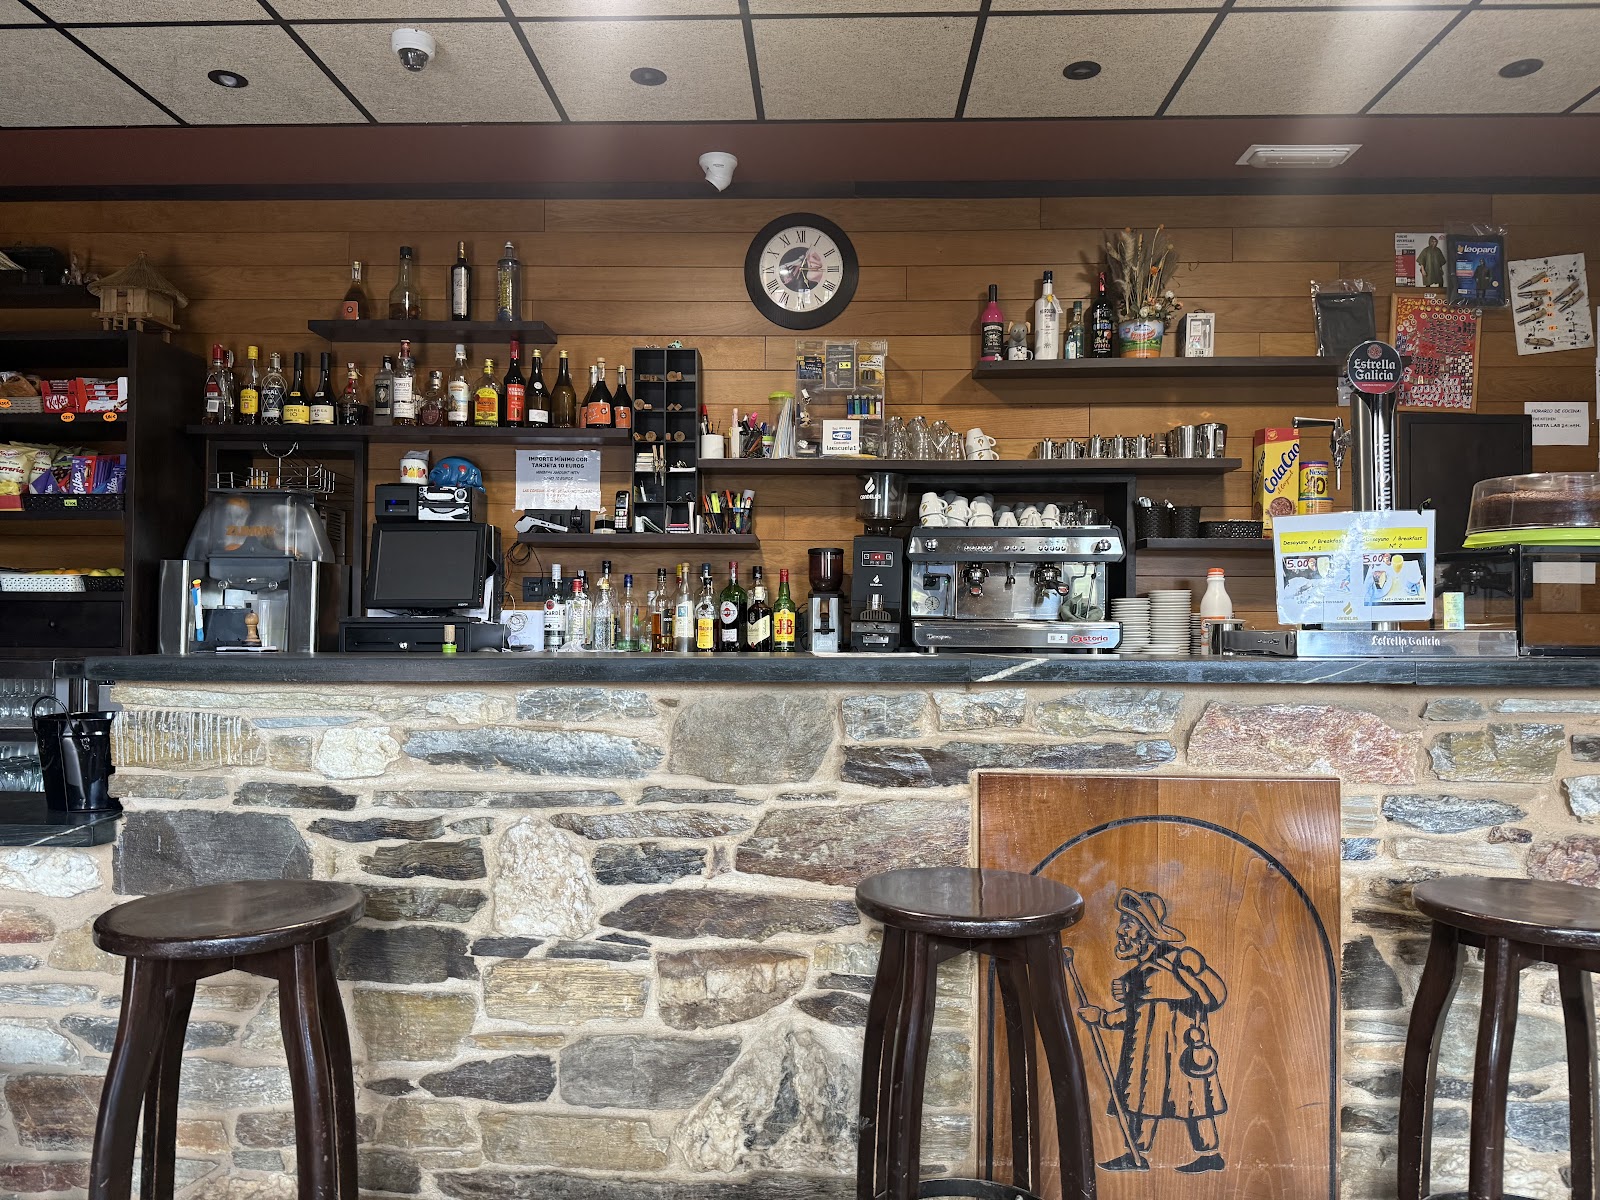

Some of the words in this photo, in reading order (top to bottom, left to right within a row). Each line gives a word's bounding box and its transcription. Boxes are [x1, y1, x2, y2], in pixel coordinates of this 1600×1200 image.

[1353, 358, 1396, 370] Estrella
[1354, 369, 1394, 381] Galicia
[1264, 442, 1300, 494] ColaCao
[1287, 559, 1309, 568] 5.00
[1371, 635, 1407, 646] Estrella
[1408, 636, 1441, 646] Galicia
